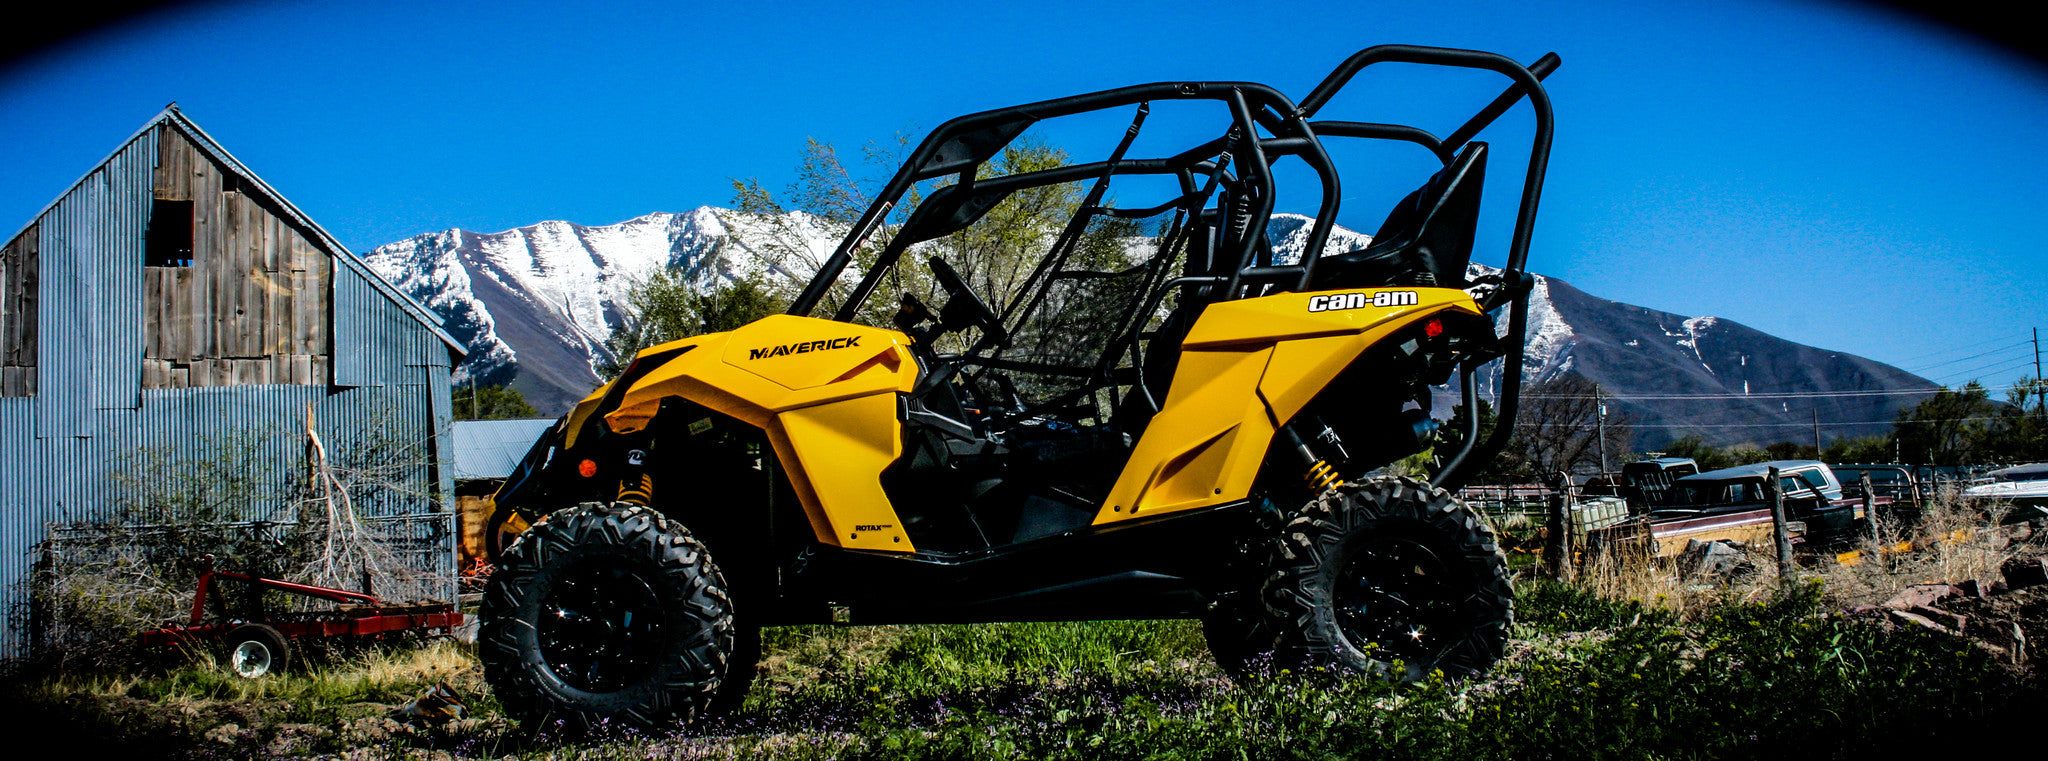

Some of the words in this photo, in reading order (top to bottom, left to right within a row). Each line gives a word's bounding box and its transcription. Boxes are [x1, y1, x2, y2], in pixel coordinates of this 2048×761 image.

[1308, 291, 1418, 312] can-am
[749, 336, 862, 360] MAVERICK
[855, 524, 882, 532] ROTAX
